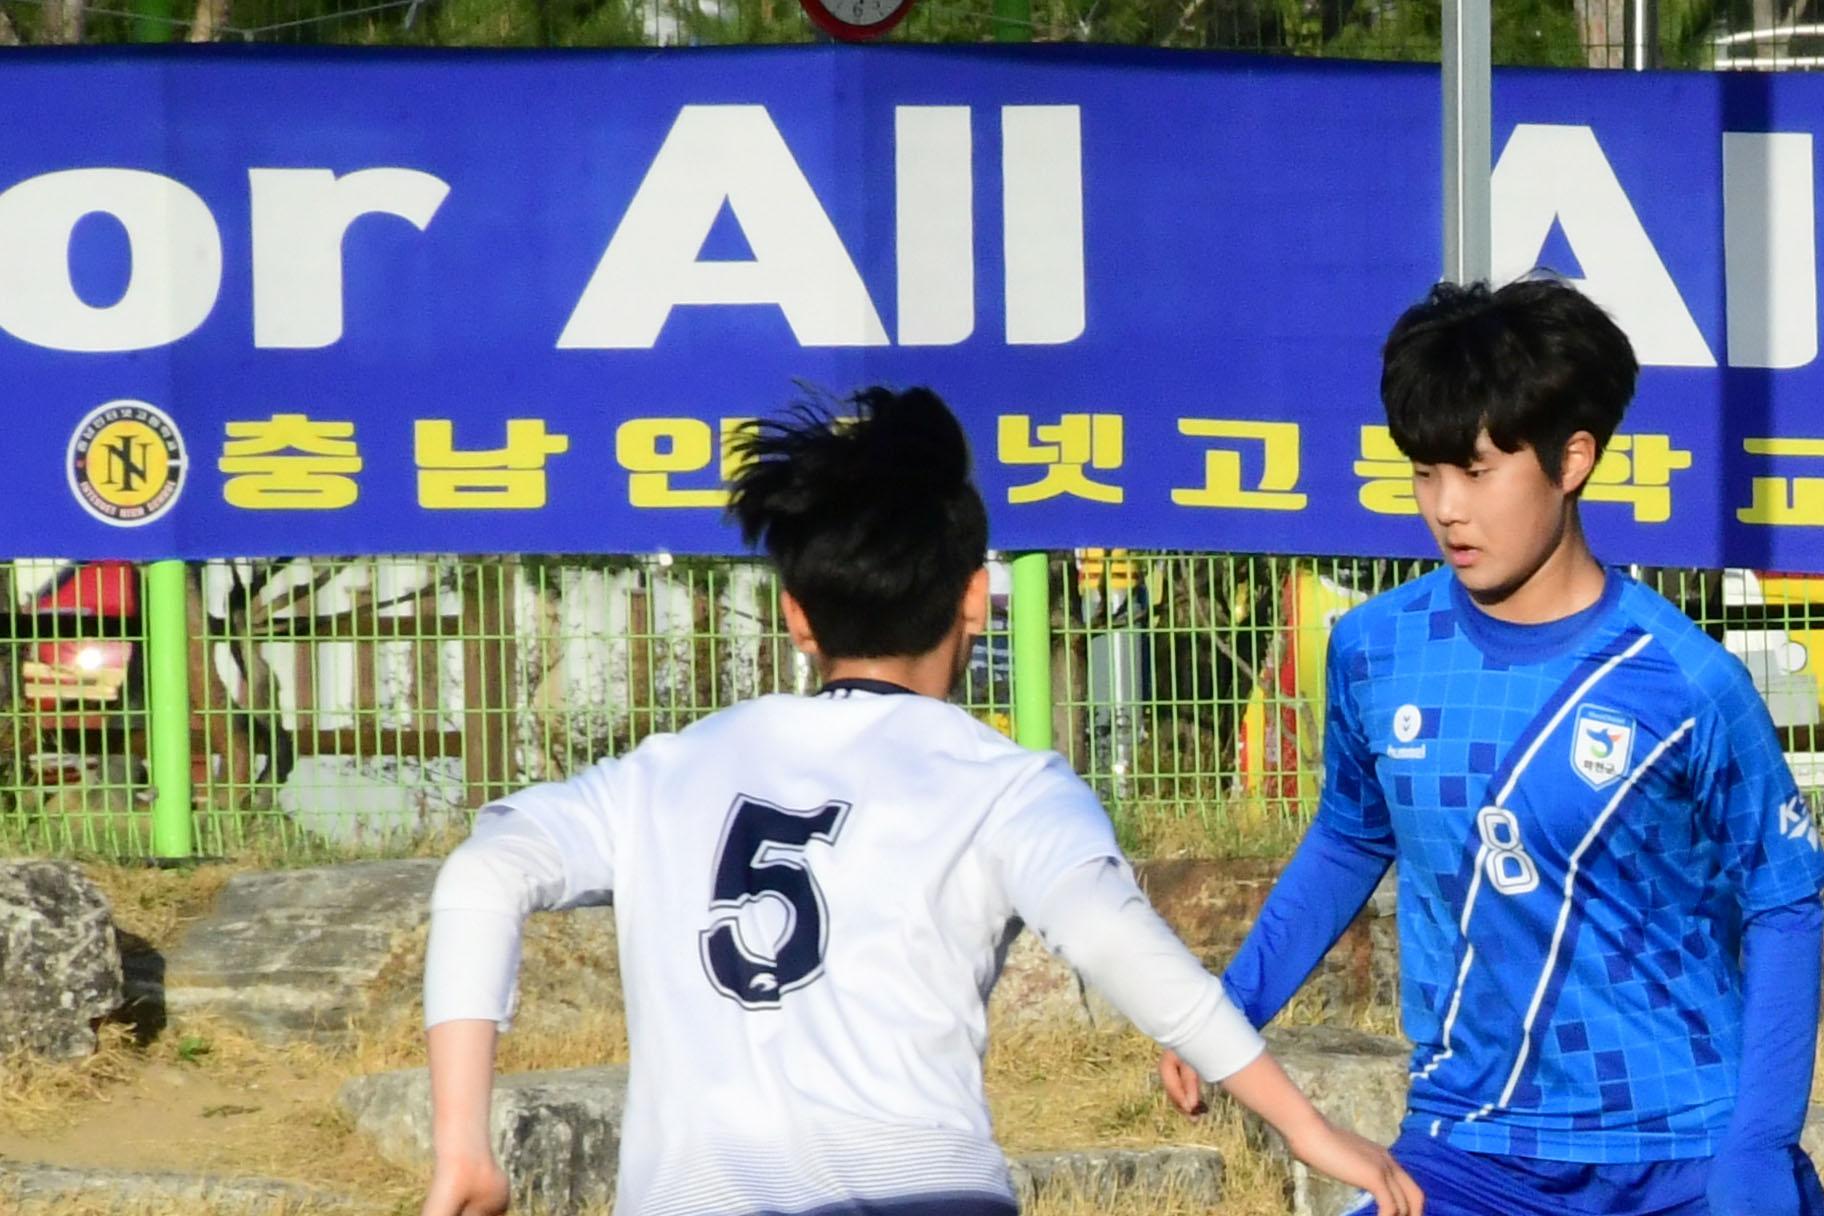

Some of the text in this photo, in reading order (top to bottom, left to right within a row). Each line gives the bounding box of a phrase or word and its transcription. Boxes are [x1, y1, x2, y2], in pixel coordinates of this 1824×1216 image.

[556, 104, 1086, 350] All
[698, 792, 853, 1012] 5
[1476, 805, 1541, 896] 8
